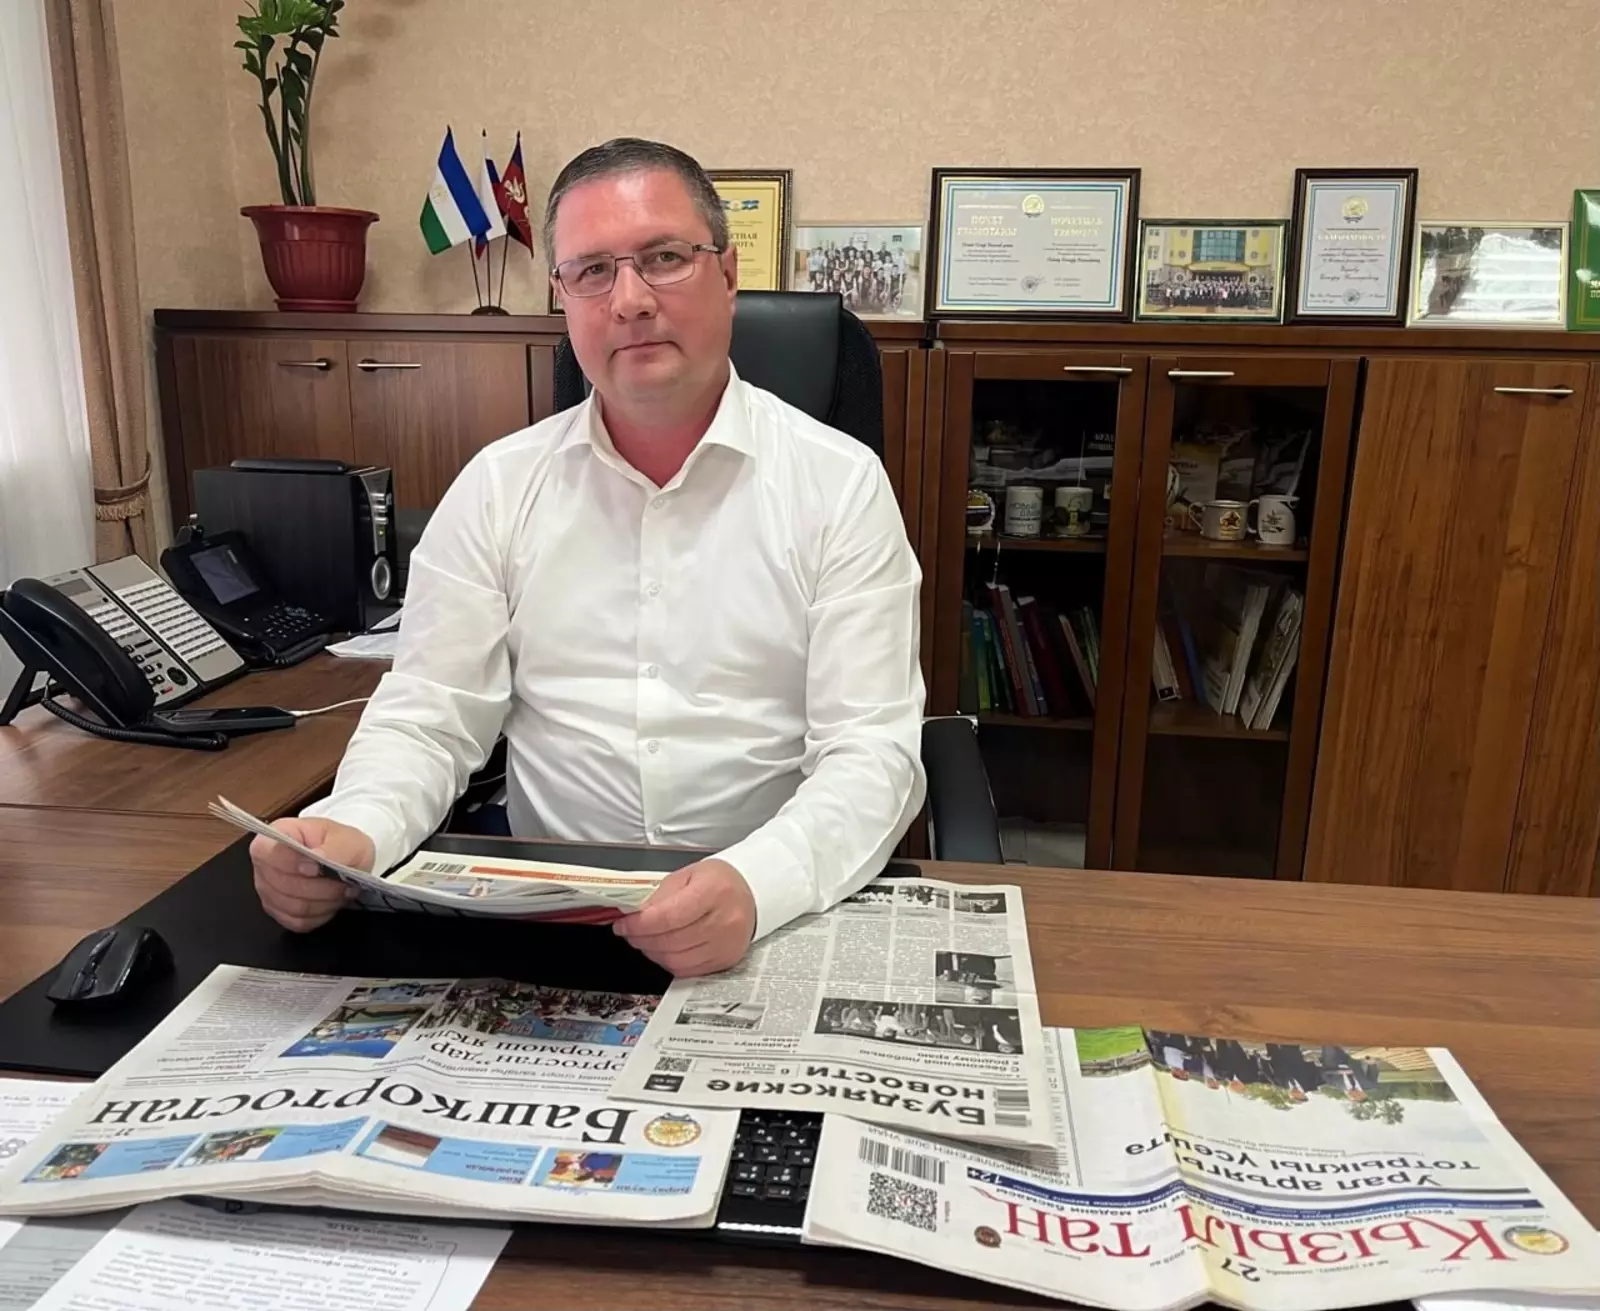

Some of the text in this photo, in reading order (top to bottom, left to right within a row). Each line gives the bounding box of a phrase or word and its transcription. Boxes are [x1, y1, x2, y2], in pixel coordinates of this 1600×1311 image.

[805, 1065, 985, 1101] новости
[706, 1080, 986, 1126] Буздякские
[1174, 1152, 1441, 1193] Урал аръягы
[1270, 1156, 1480, 1176] тотрыклы
[1172, 1205, 1517, 1266] Кызыл
[1220, 1257, 1261, 1283] 27
